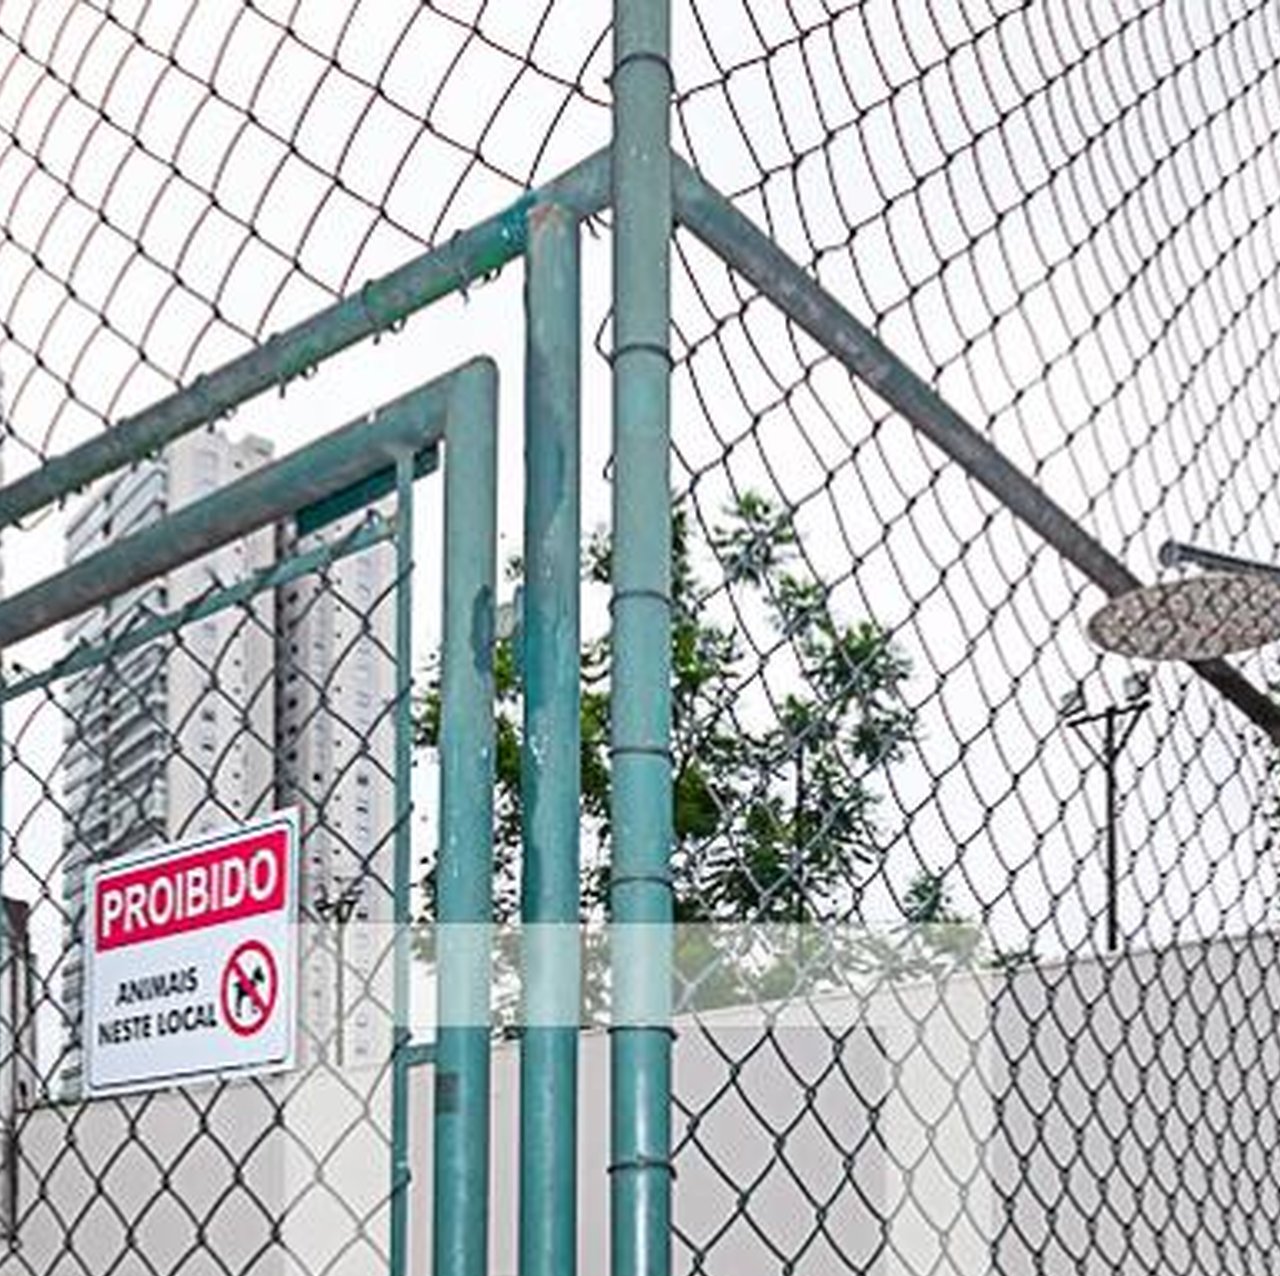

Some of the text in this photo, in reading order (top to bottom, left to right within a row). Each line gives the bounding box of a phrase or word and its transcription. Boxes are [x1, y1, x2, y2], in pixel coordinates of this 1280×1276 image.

[101, 849, 278, 938] PROIBIDO
[115, 966, 198, 1007] ANIMAIS
[98, 1004, 218, 1046] NESTE LOCAL
